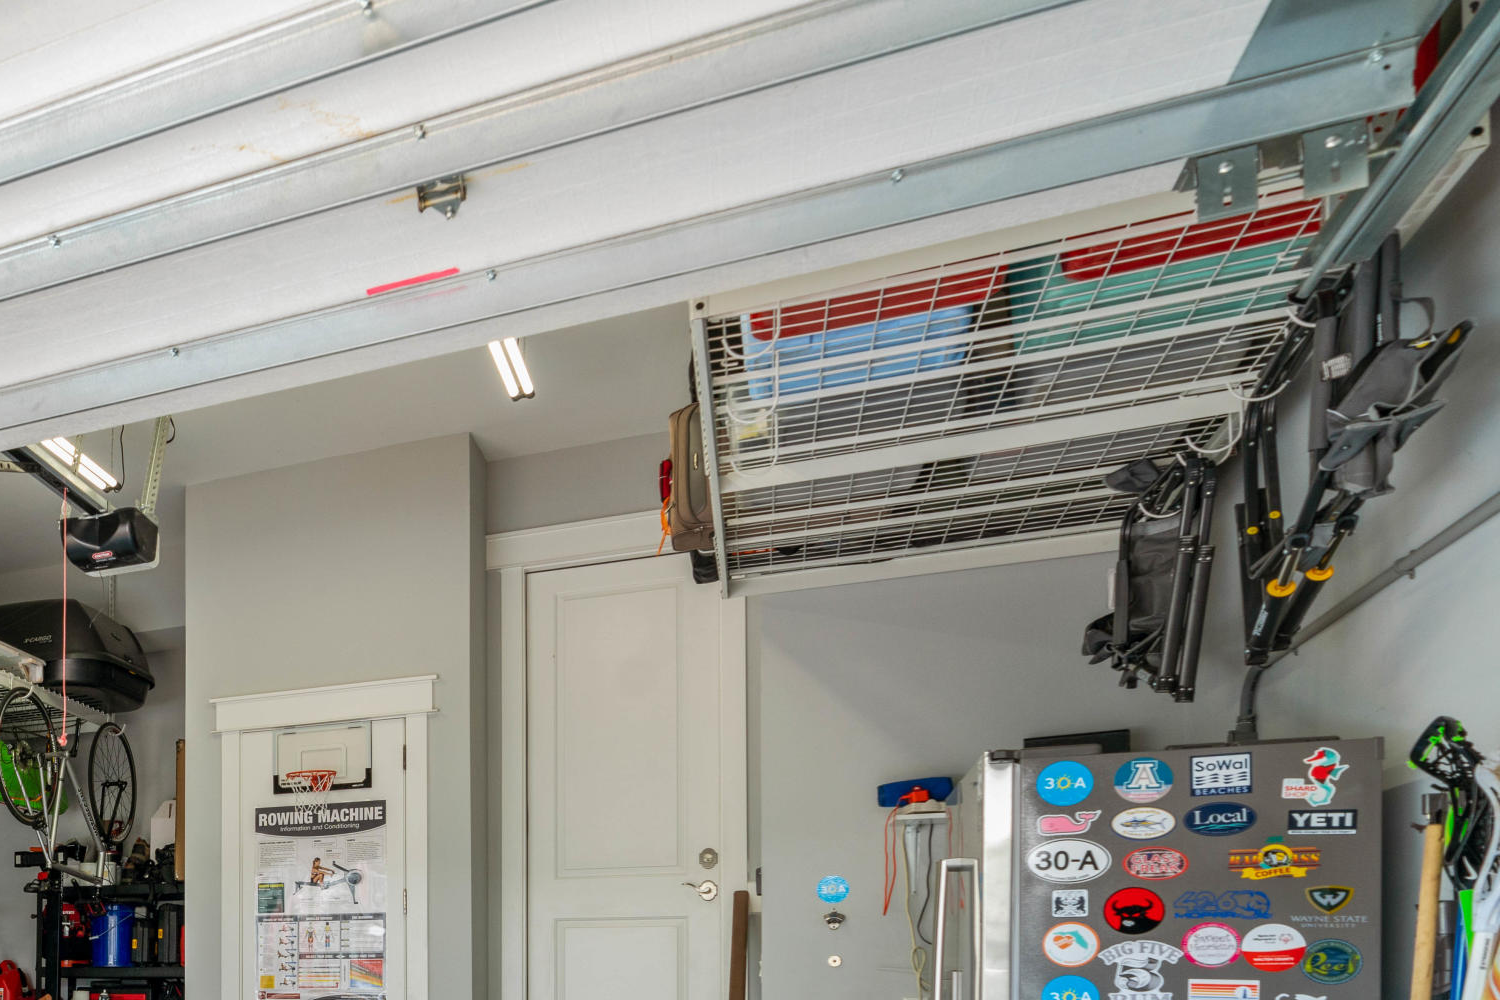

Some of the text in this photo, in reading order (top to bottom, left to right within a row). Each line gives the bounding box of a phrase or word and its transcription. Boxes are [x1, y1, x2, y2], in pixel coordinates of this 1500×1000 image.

[1195, 758, 1248, 772] SoWal
[1195, 786, 1249, 796] BEACHES
[258, 806, 383, 826] ROWING MACHINE
[1194, 808, 1248, 825] Local
[1291, 812, 1354, 828] YETI
[324, 822, 360, 830] Conditioning
[1035, 850, 1100, 871] 30-A
[1131, 852, 1180, 864] GLASS
[1255, 868, 1291, 878] COFFEE
[1101, 943, 1134, 963] BIG
[1139, 942, 1178, 962] FIVE
